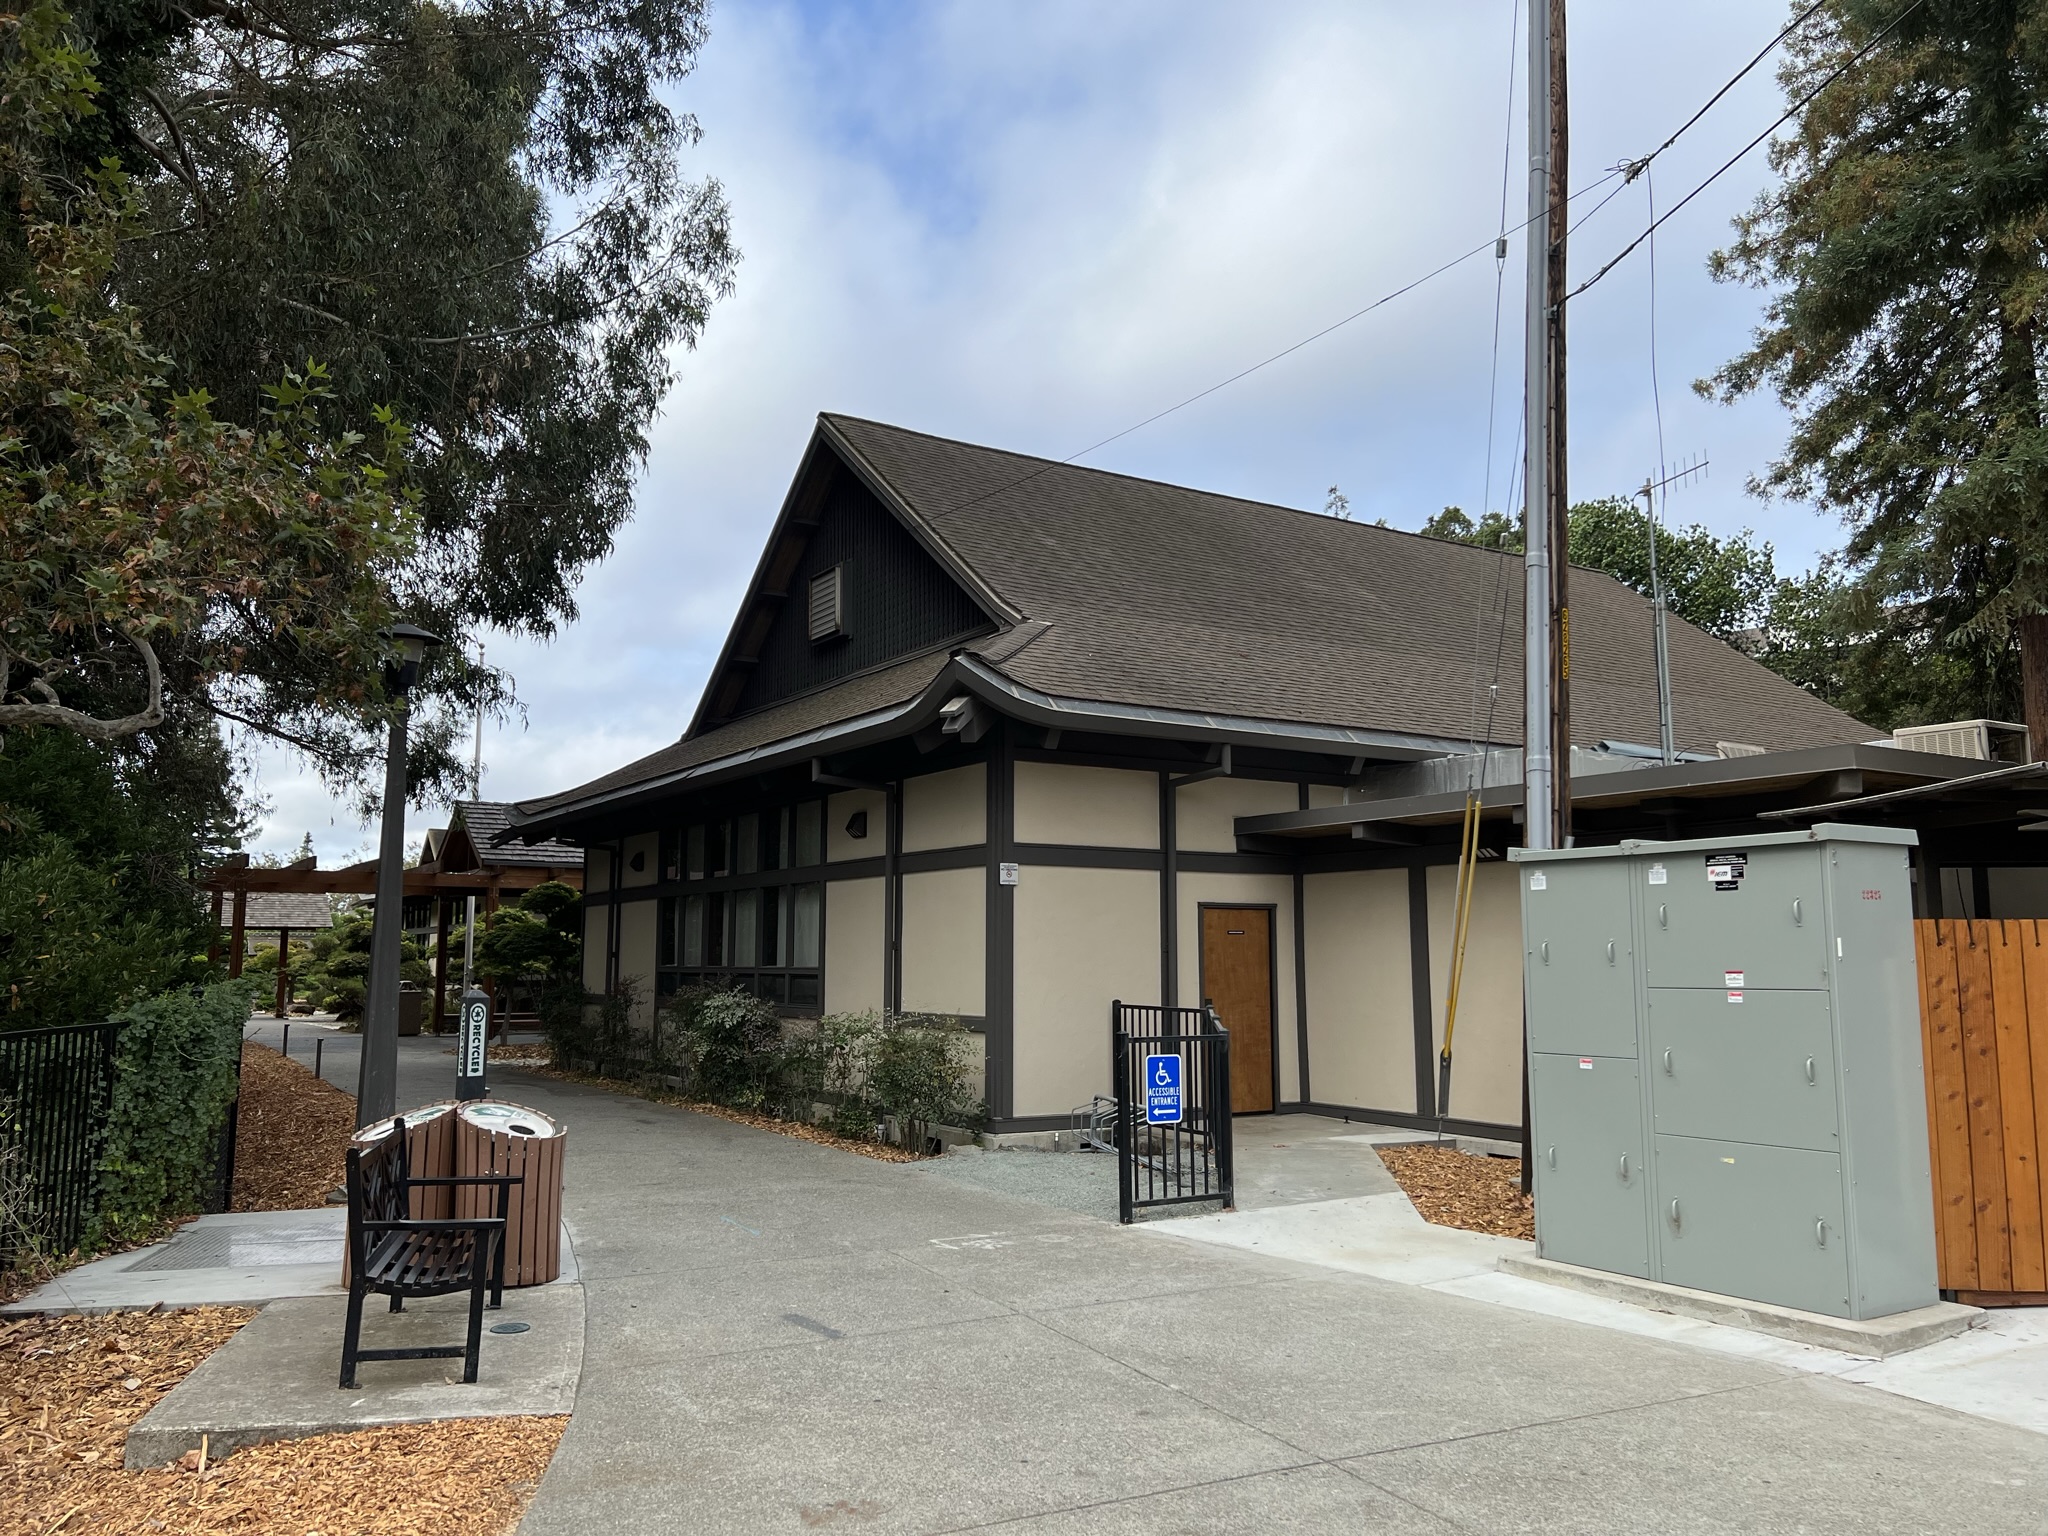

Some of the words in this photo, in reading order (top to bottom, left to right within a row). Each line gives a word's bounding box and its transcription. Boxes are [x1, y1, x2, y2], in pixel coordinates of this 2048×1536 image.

[471, 1024, 482, 1067] RECYCLE
[1149, 1087, 1180, 1096] ACCESSIBLE
[1151, 1097, 1178, 1106] ENTRANCE
